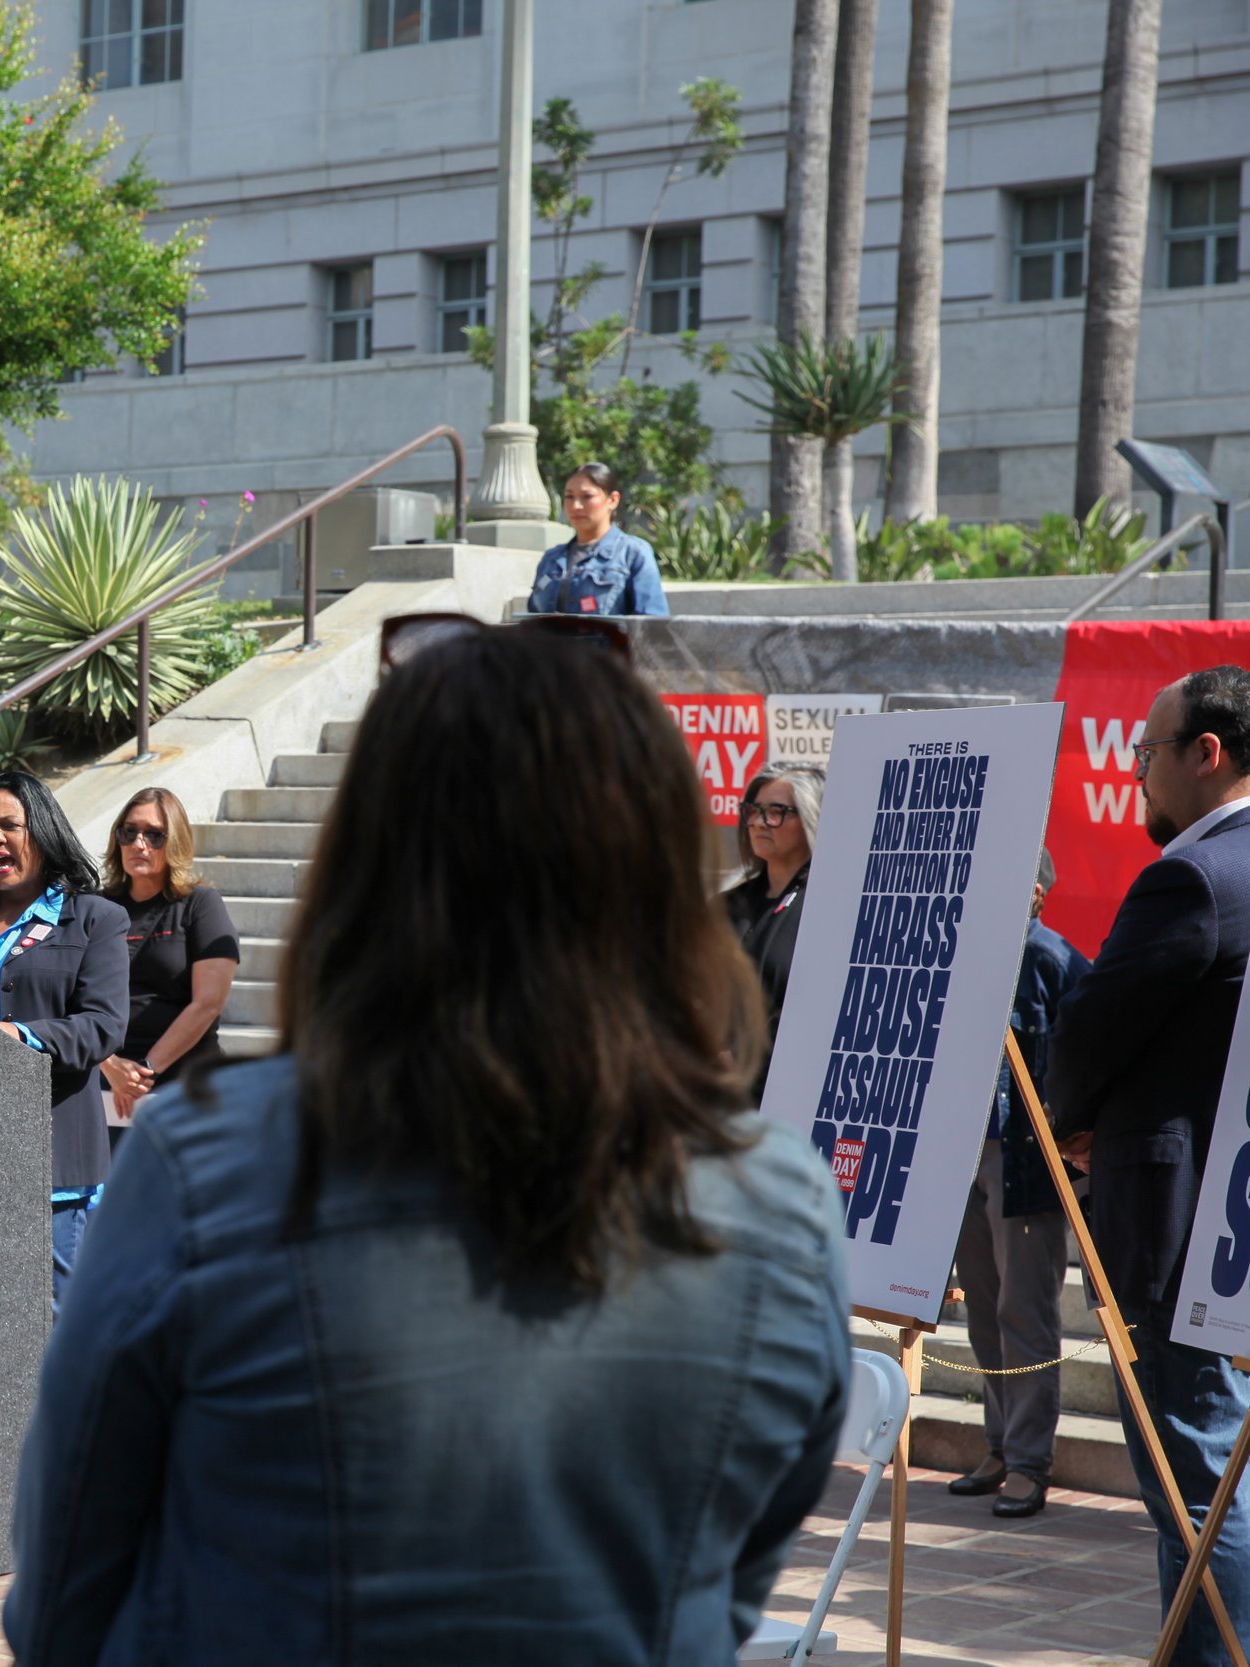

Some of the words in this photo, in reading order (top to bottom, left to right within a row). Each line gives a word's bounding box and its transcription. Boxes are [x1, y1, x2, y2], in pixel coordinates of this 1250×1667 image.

[775, 707, 865, 731] SEXU
[696, 740, 760, 789] AY
[908, 742, 953, 756] THERE
[955, 741, 969, 755] IS
[877, 758, 910, 811] NO
[907, 755, 990, 810] EXCUSE
[870, 812, 905, 851] AND
[903, 811, 955, 851] NEVER
[952, 810, 981, 851] AN
[862, 853, 951, 894] INVITATION
[949, 852, 972, 894] TO
[849, 894, 964, 969] HARASS
[831, 965, 951, 1059] ABUSE
[815, 1052, 934, 1130] ASSAULT
[831, 1156, 860, 1177] DAY
[836, 1142, 863, 1156] DENIM
[841, 1179, 854, 1187] 1999
[889, 1283, 930, 1299] denimday.org
